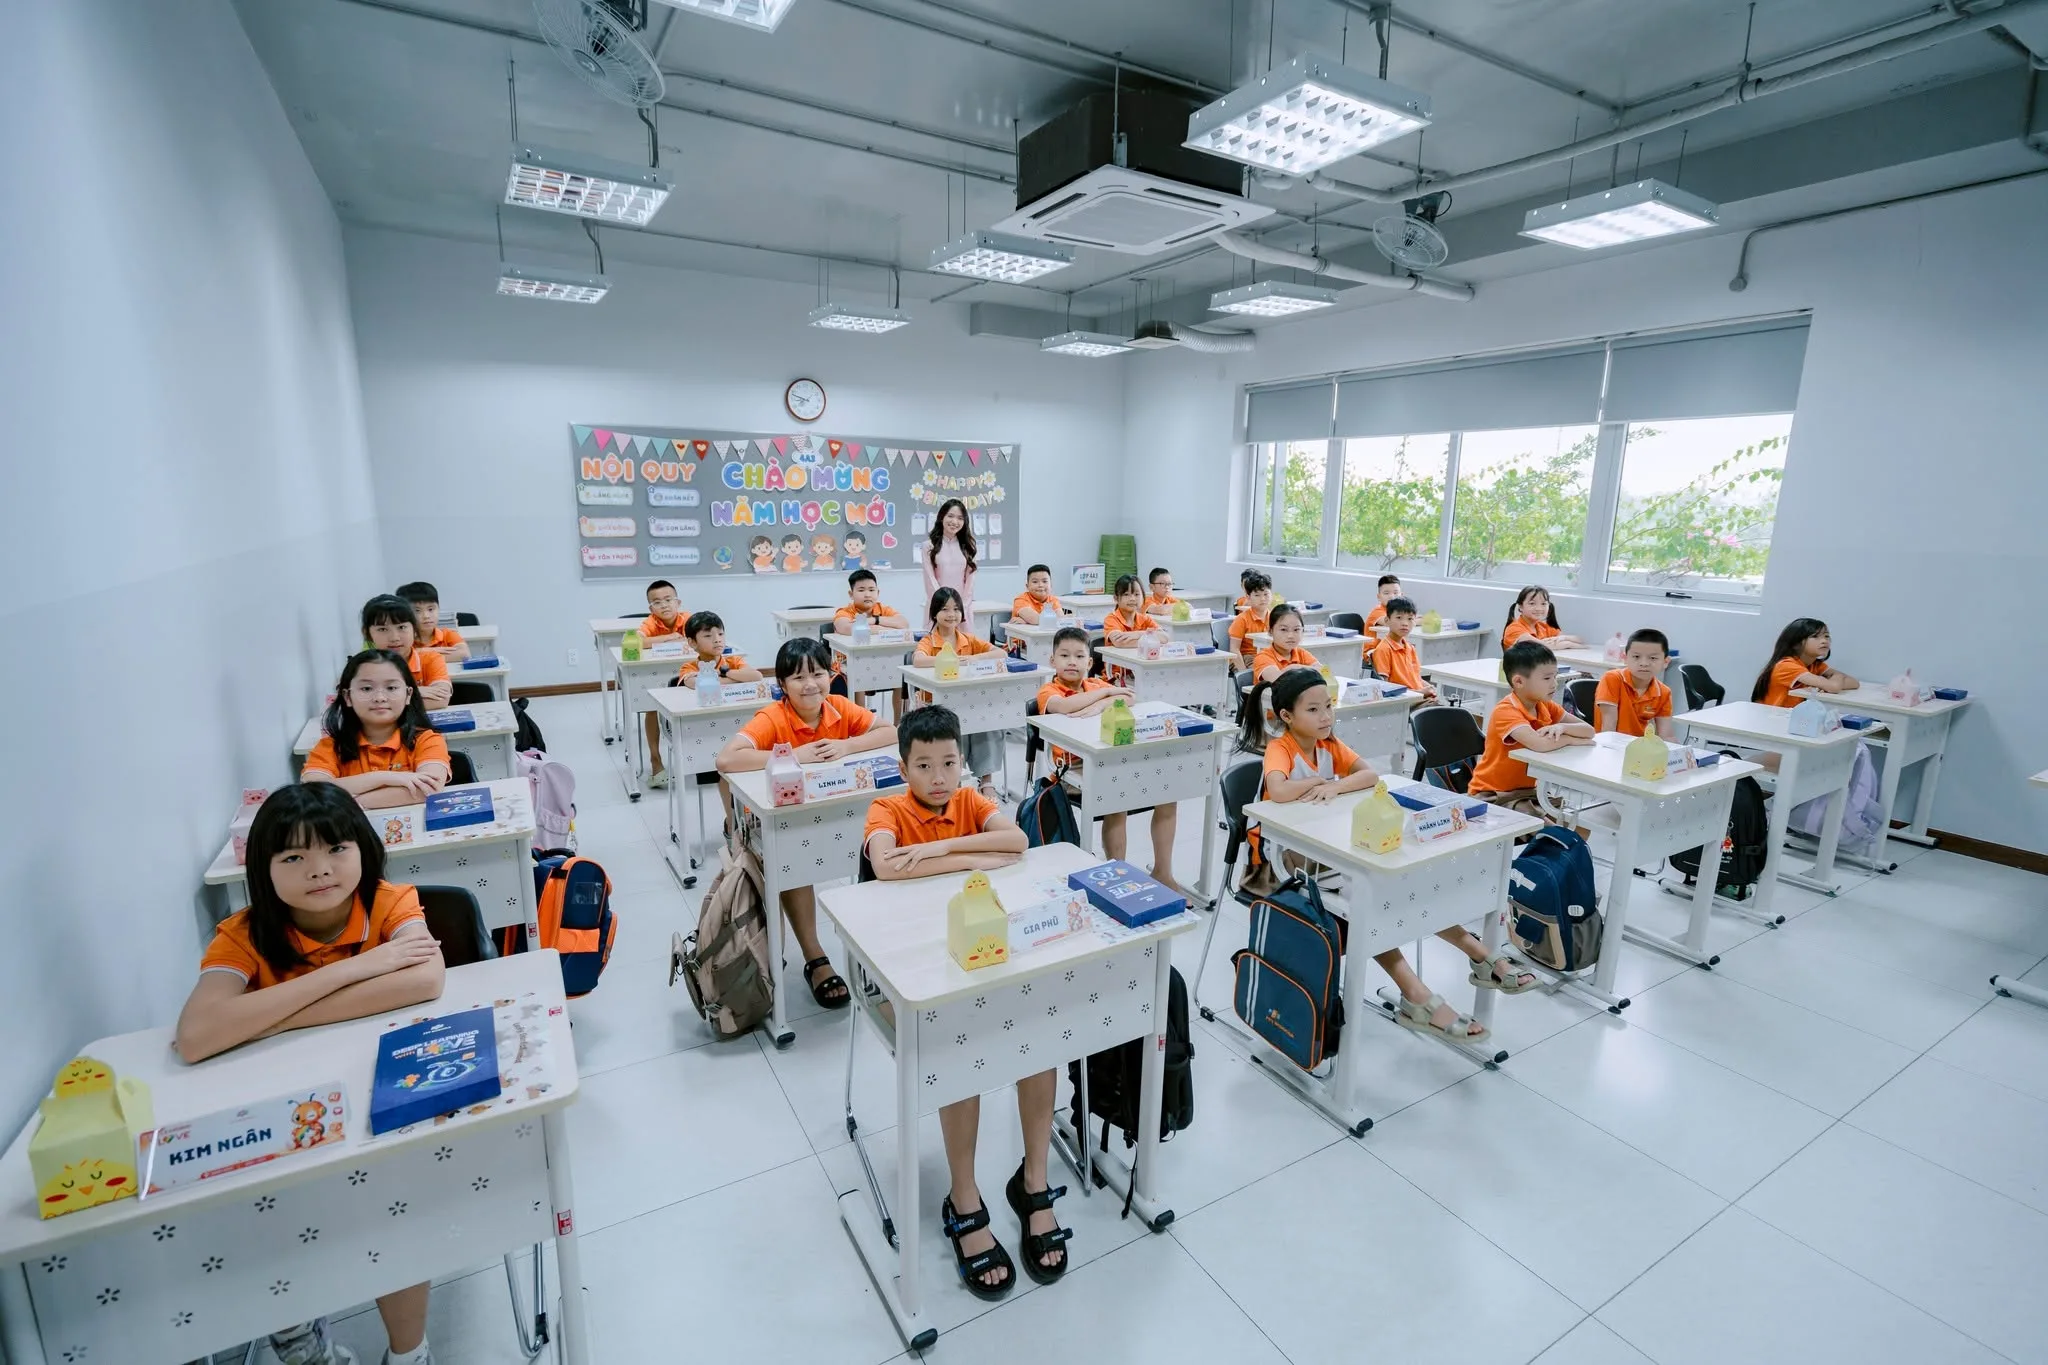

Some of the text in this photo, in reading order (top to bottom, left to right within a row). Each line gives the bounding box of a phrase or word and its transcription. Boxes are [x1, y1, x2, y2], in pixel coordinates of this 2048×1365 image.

[581, 452, 697, 485] NỘI QUY
[722, 456, 891, 492] CHÀO MỪNG
[936, 474, 985, 491] HAPPY
[710, 494, 896, 531] NĂM HỌC MỚI
[922, 489, 993, 510] BIRDAY
[818, 780, 837, 789] LINH
[1023, 923, 1041, 935] GIA
[391, 1043, 423, 1058] DEEP
[423, 1029, 480, 1047] LEARNING
[169, 1143, 211, 1166] KIM
[218, 1127, 272, 1153] NGÂN
